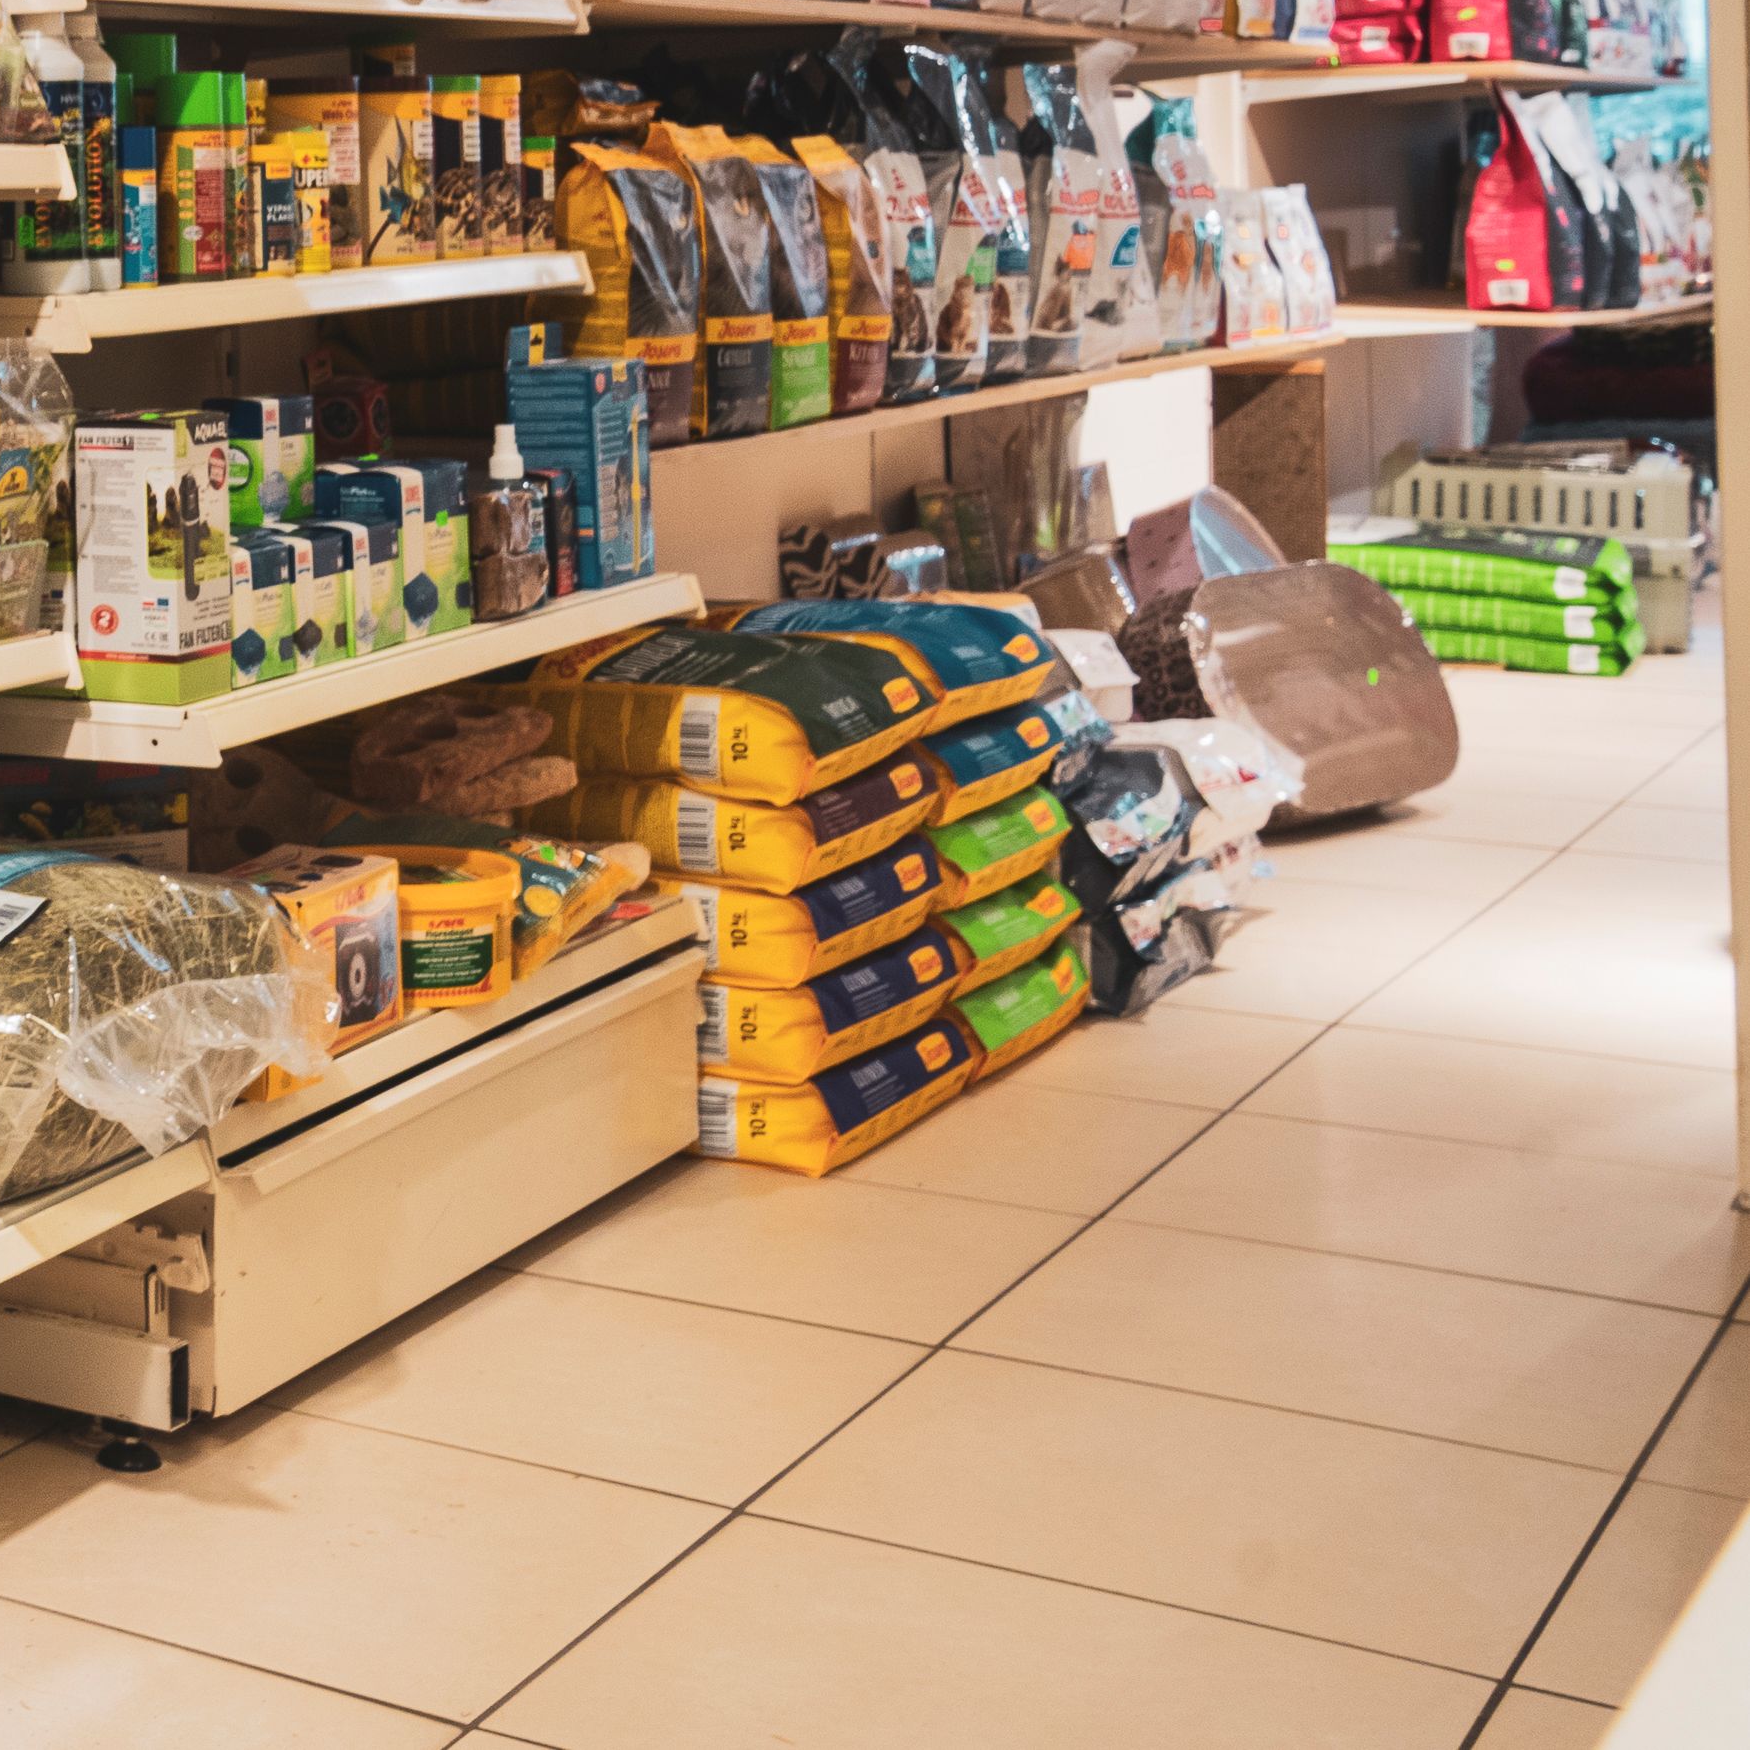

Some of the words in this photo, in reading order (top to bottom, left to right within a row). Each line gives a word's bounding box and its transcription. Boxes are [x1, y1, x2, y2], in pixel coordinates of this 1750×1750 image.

[179, 630, 194, 649] FAN
[731, 742, 749, 762] 10
[729, 833, 747, 852] 10
[740, 1022, 757, 1043] 10
